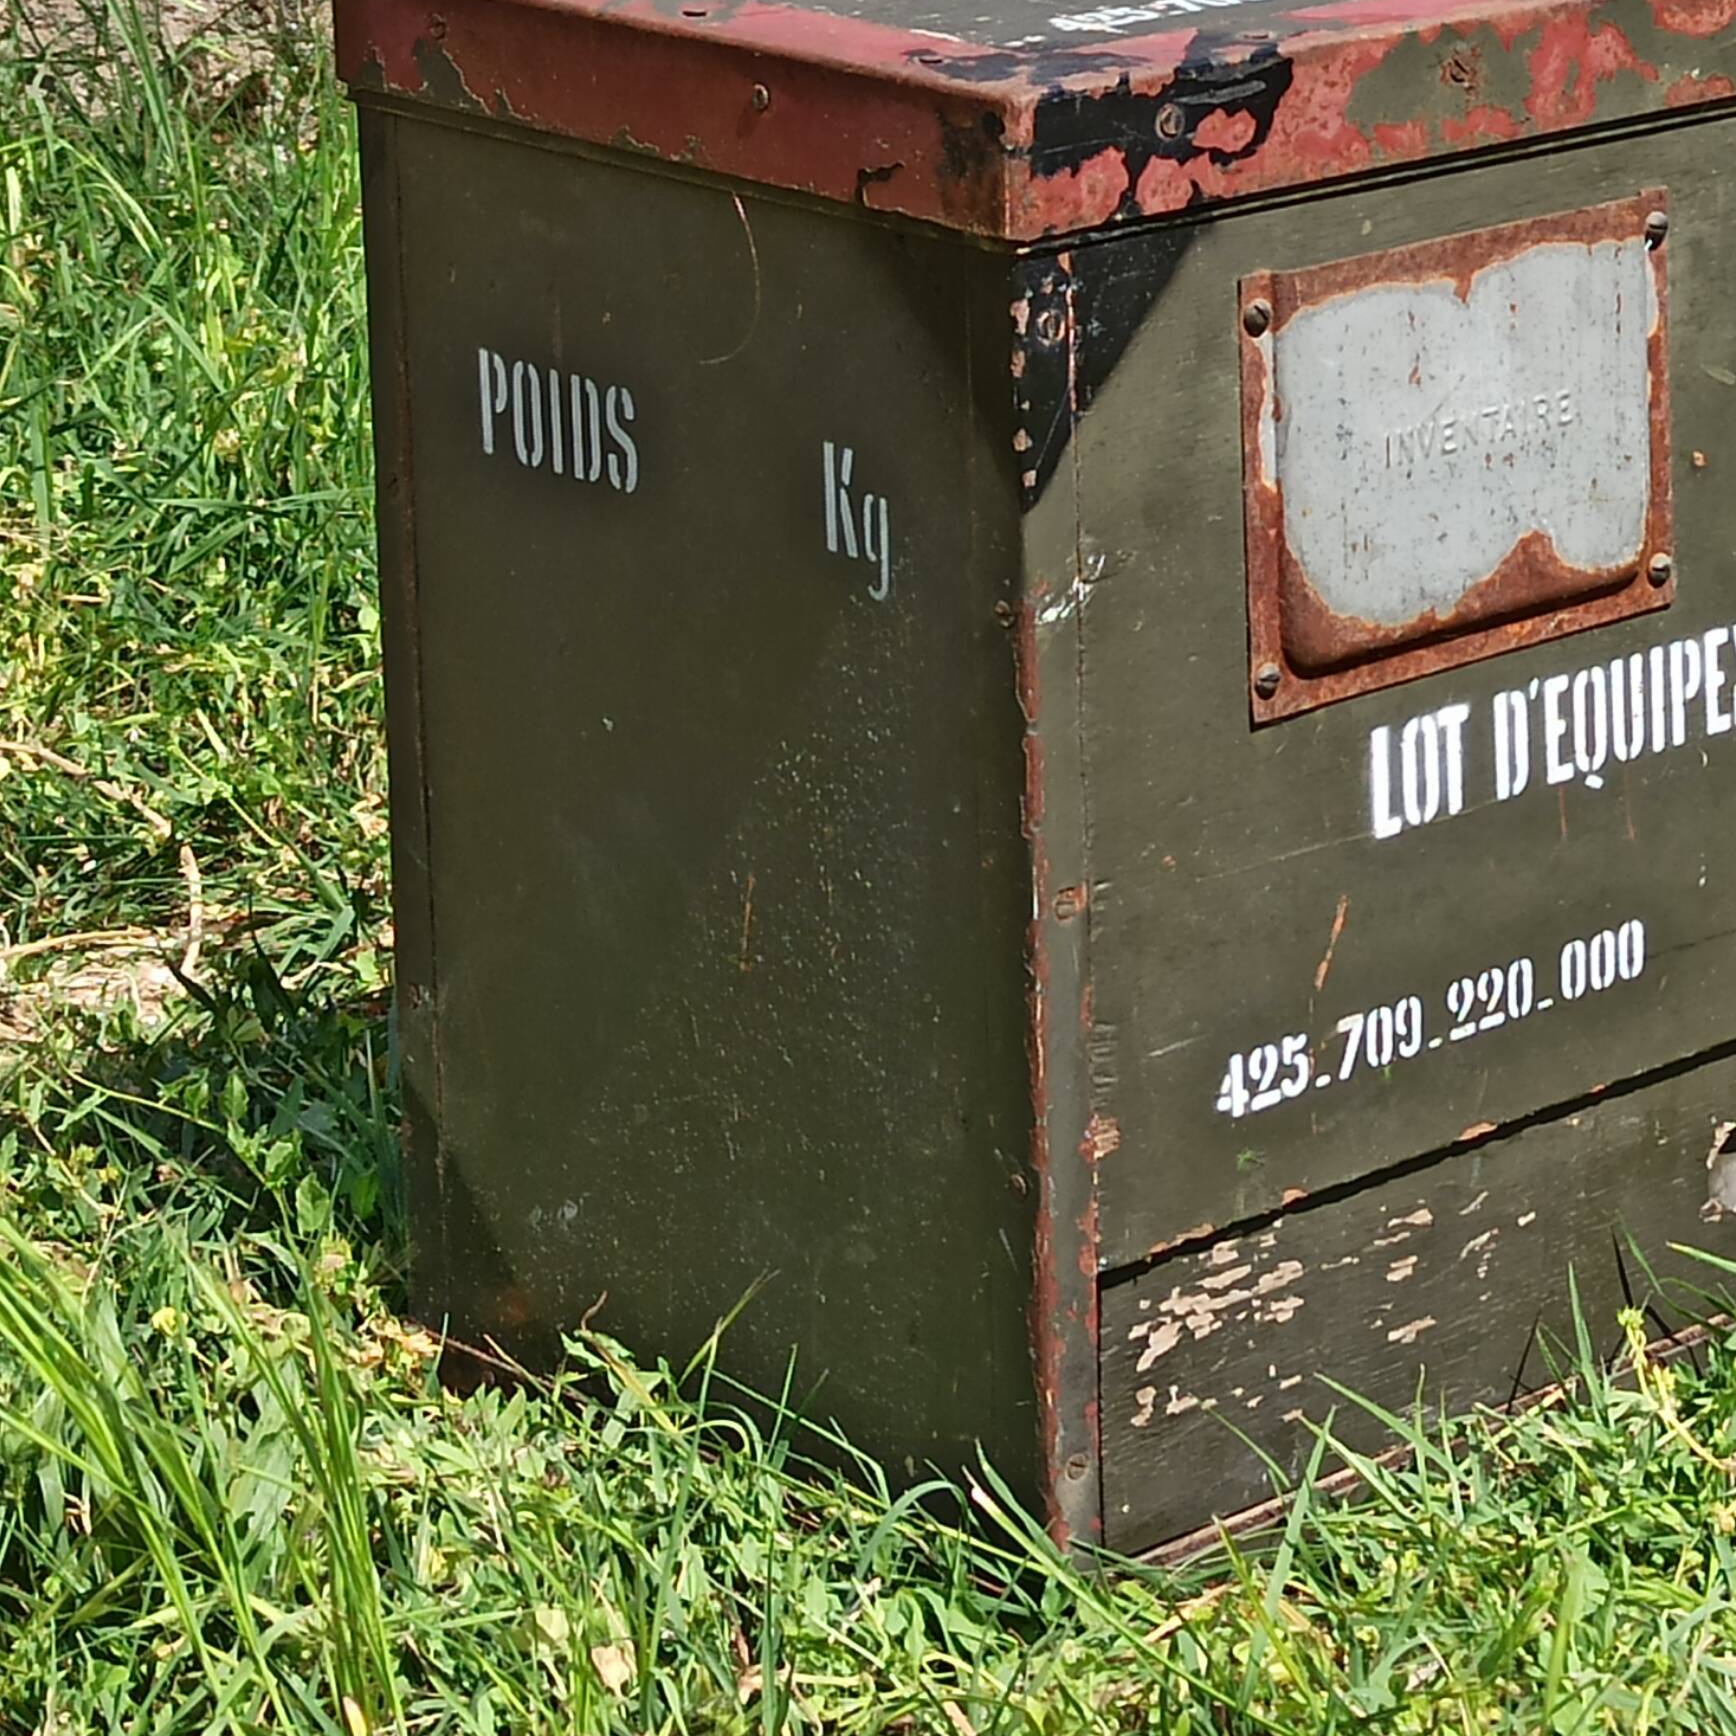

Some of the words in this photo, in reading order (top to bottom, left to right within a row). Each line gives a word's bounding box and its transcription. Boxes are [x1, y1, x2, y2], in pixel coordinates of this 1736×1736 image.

[478, 347, 639, 494] POIDS
[823, 441, 890, 601] Kg
[1383, 387, 1577, 470] INVENTAIRE
[1369, 702, 1470, 840] LOT
